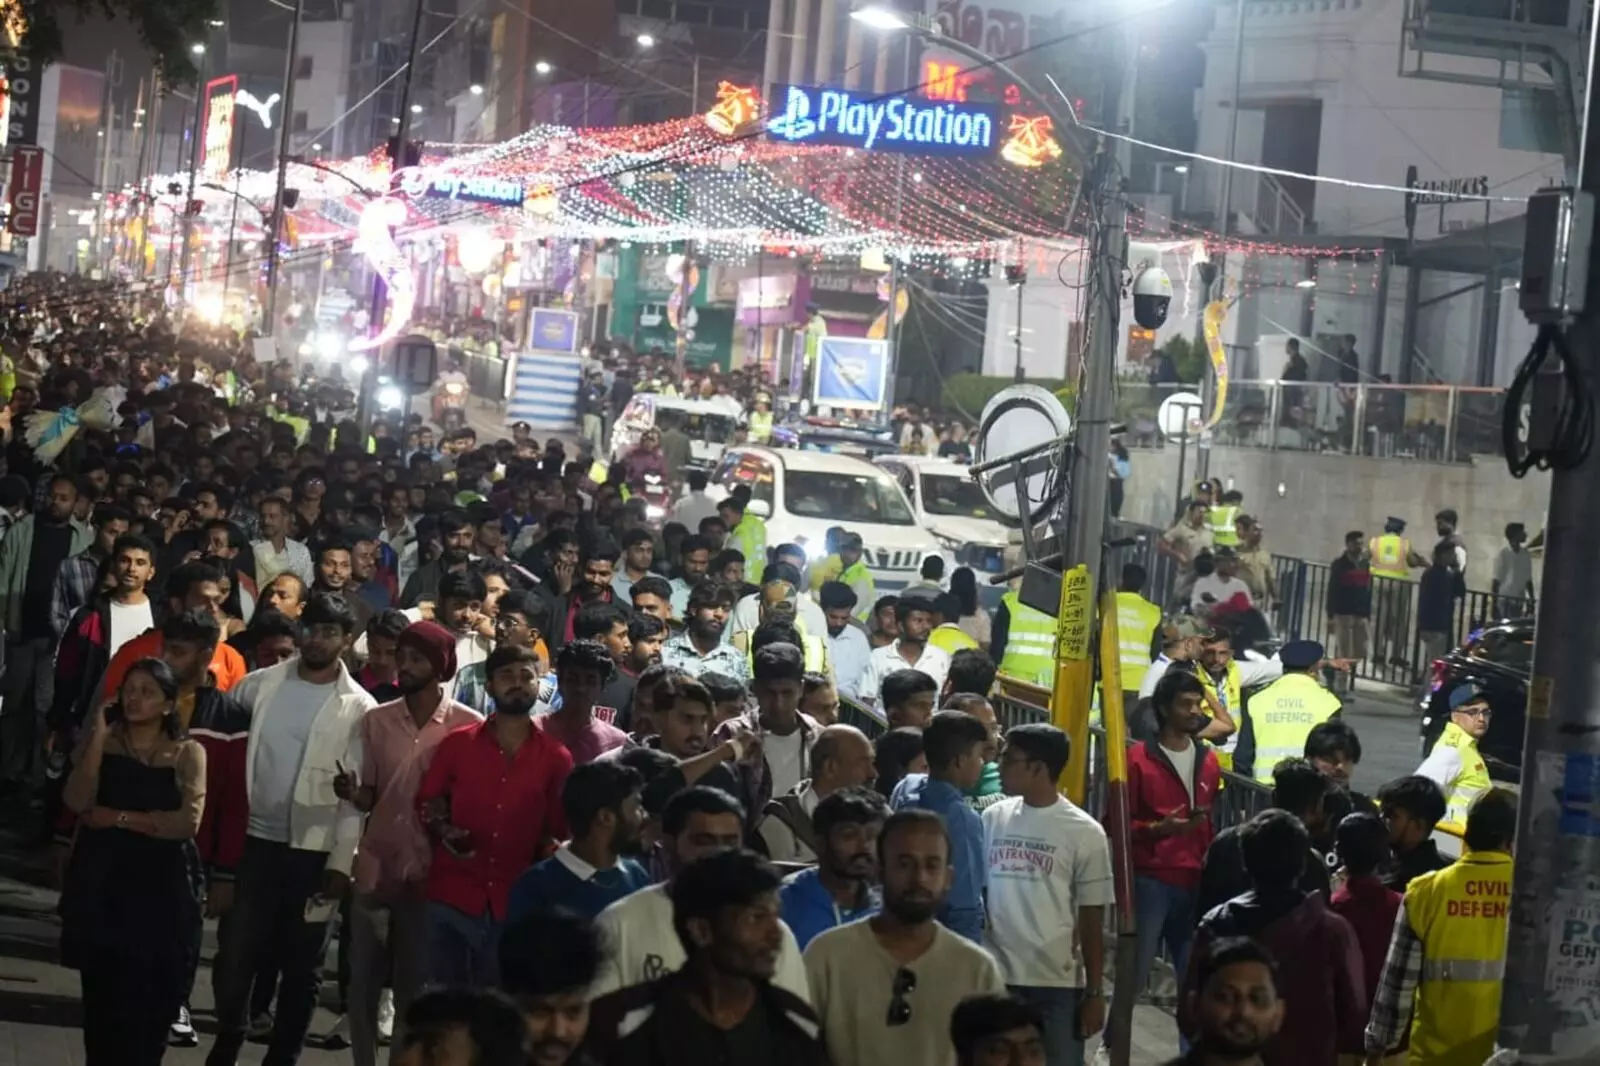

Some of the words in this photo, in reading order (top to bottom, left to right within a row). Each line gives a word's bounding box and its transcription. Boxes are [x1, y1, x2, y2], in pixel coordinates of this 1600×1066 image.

[818, 91, 991, 149] PlayStation
[12, 151, 38, 232] TIGC
[1275, 697, 1305, 709] CIVIL
[1265, 711, 1315, 724] DEFENCE
[1465, 879, 1510, 897] CIVIL
[1559, 942, 1600, 958] GEN
